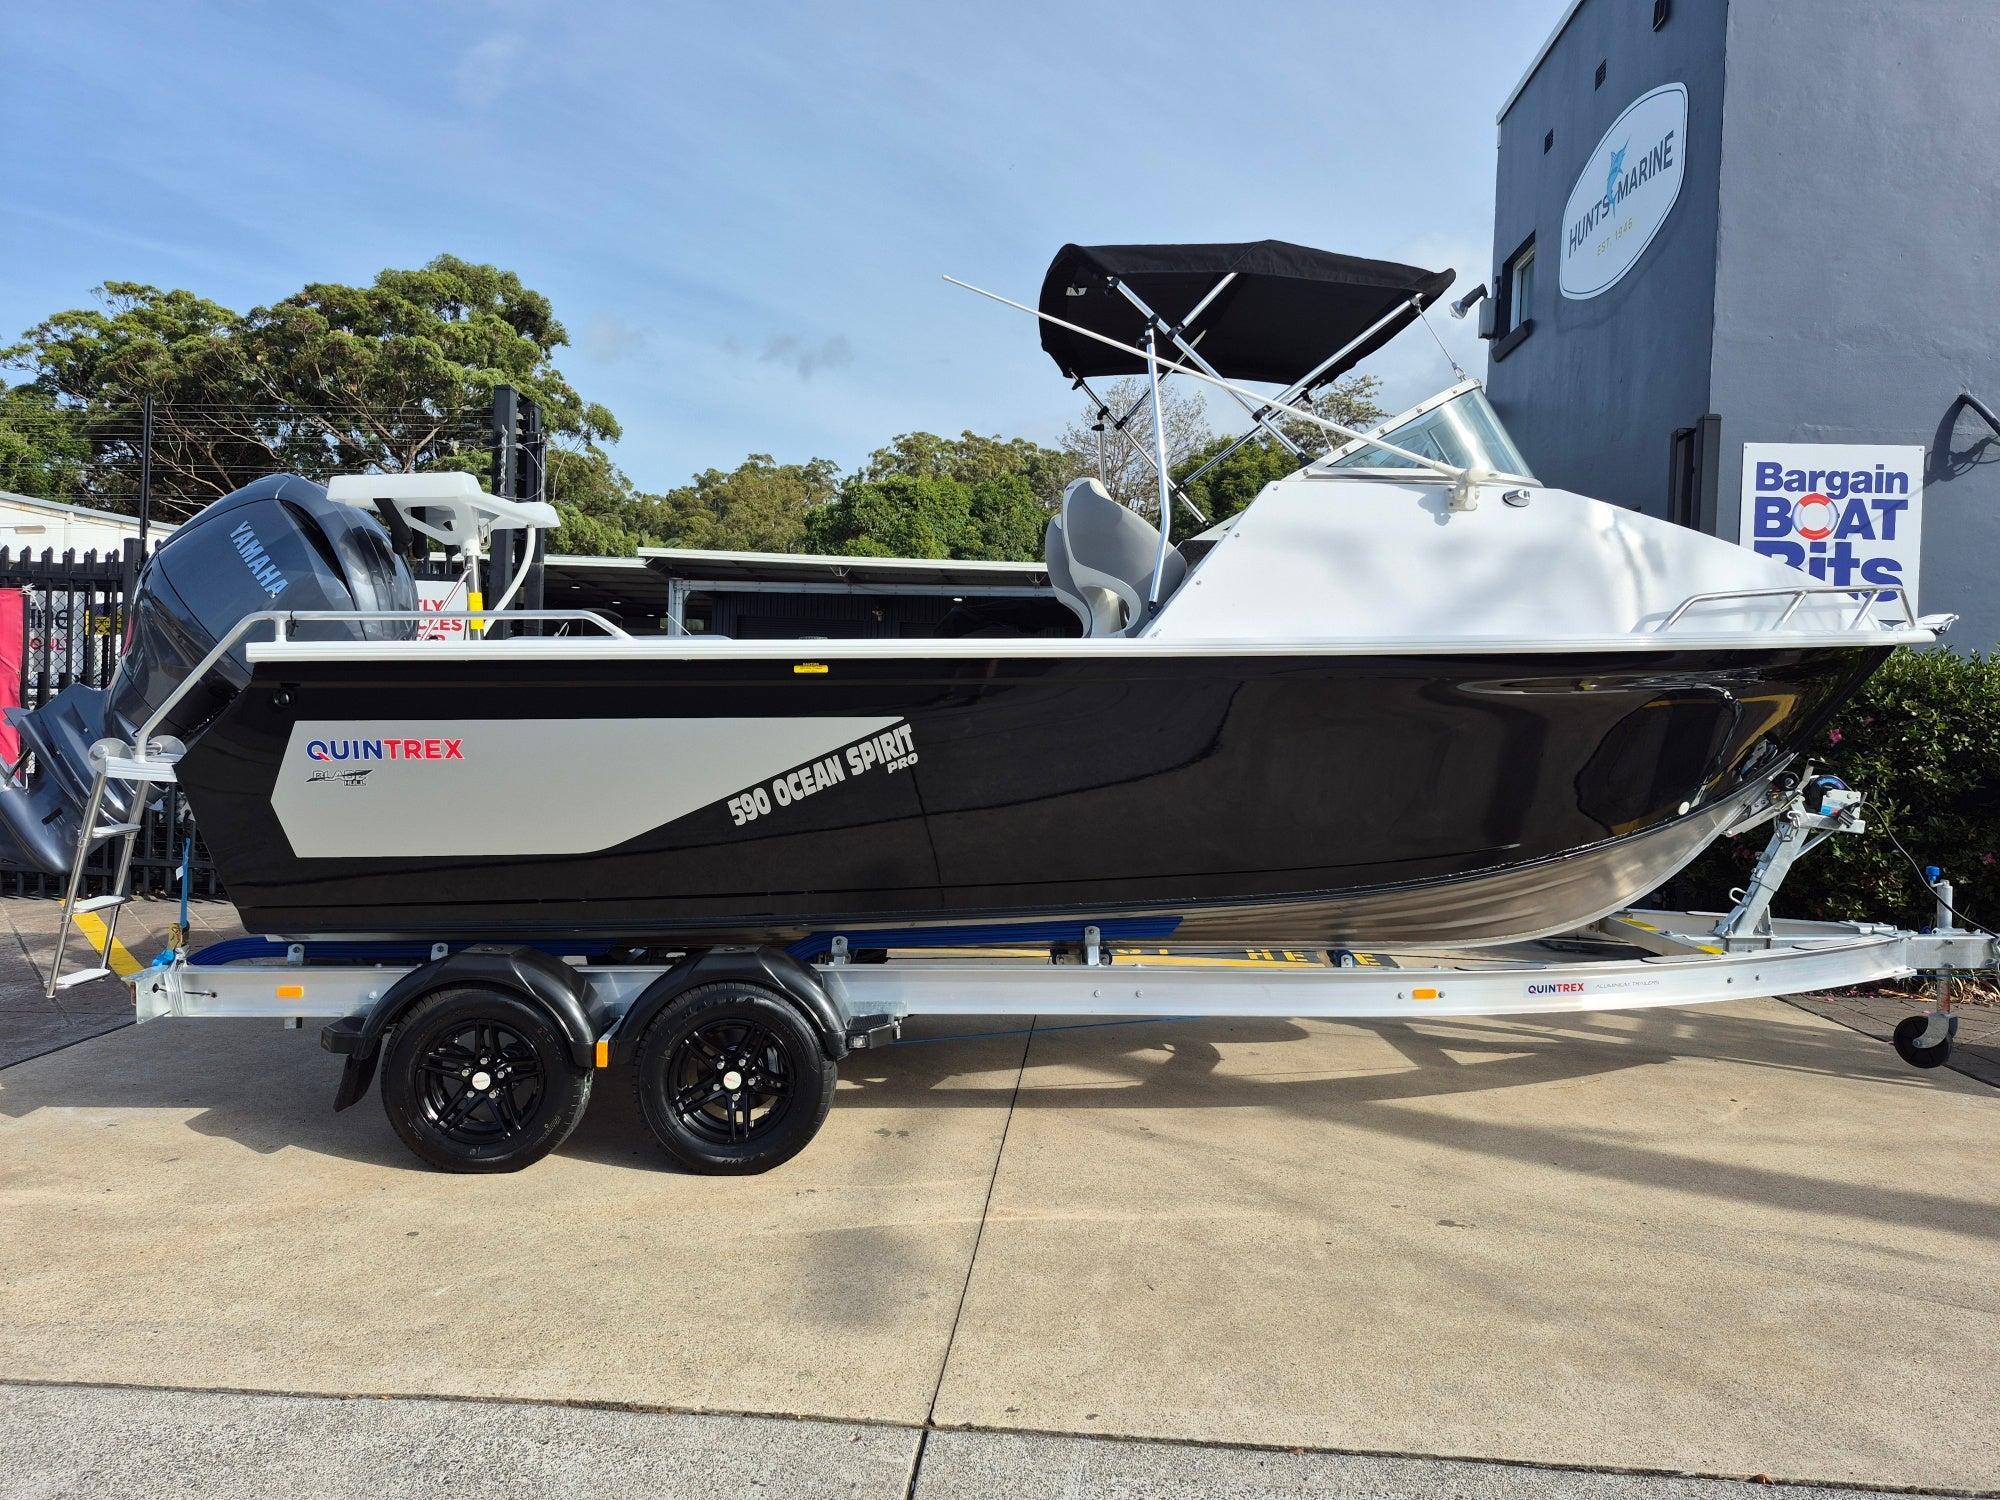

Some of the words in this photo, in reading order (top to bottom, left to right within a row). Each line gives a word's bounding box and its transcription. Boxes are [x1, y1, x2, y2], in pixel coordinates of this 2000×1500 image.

[1568, 194, 1611, 260] HUNTS
[1616, 129, 1675, 204] MARINE
[1755, 461, 1909, 500] Bargain
[1753, 496, 1909, 541] BOAT
[229, 519, 289, 600] YAMAHA
[305, 739, 465, 762] QUINTREX
[886, 752, 919, 775] PRO
[727, 787, 772, 827] 590
[772, 754, 846, 807] OCEAN
[845, 723, 915, 776] SPIRIT
[1527, 982, 1585, 994] QUINTREX
